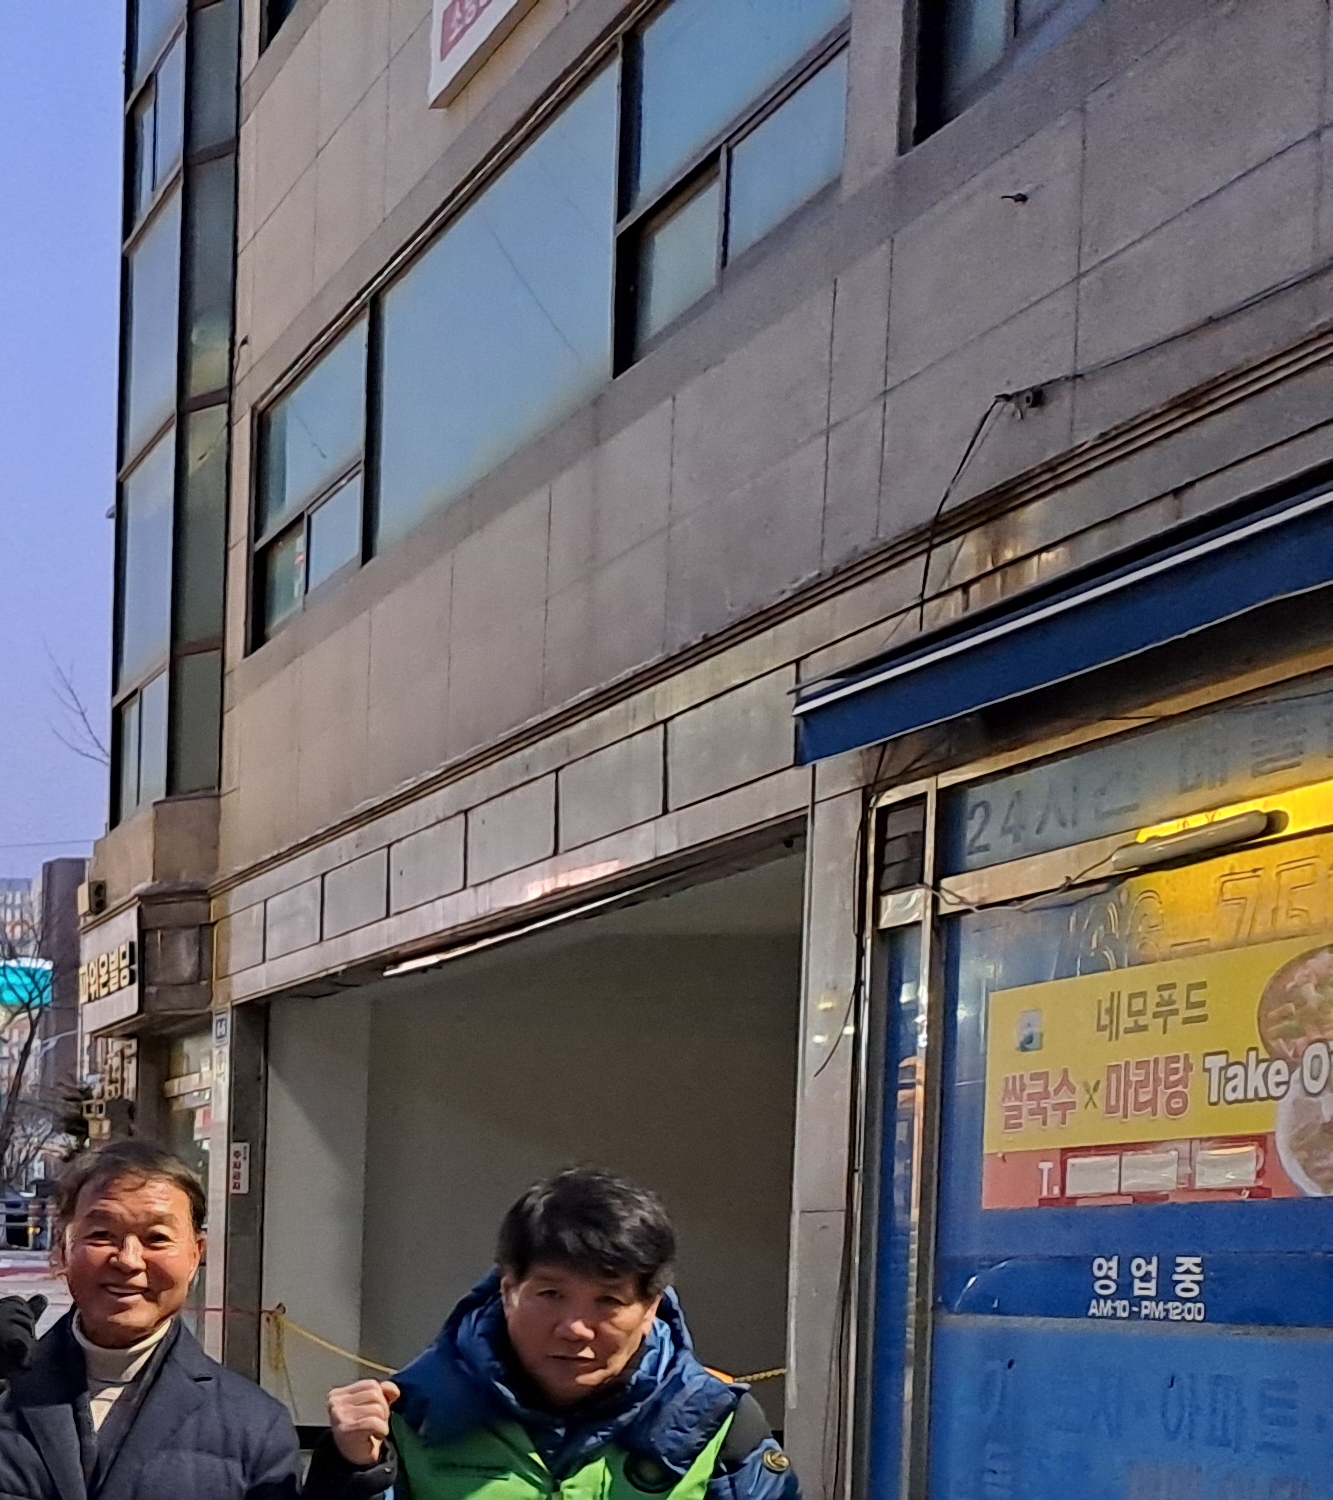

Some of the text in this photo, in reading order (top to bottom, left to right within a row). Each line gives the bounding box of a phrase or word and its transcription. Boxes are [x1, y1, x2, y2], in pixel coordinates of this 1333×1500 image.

[1096, 980, 1209, 1042] 네모푸드
[1001, 1067, 1078, 1132] 쌀국수
[1103, 1052, 1195, 1121] 마라탕
[1203, 1046, 1290, 1107] Take
